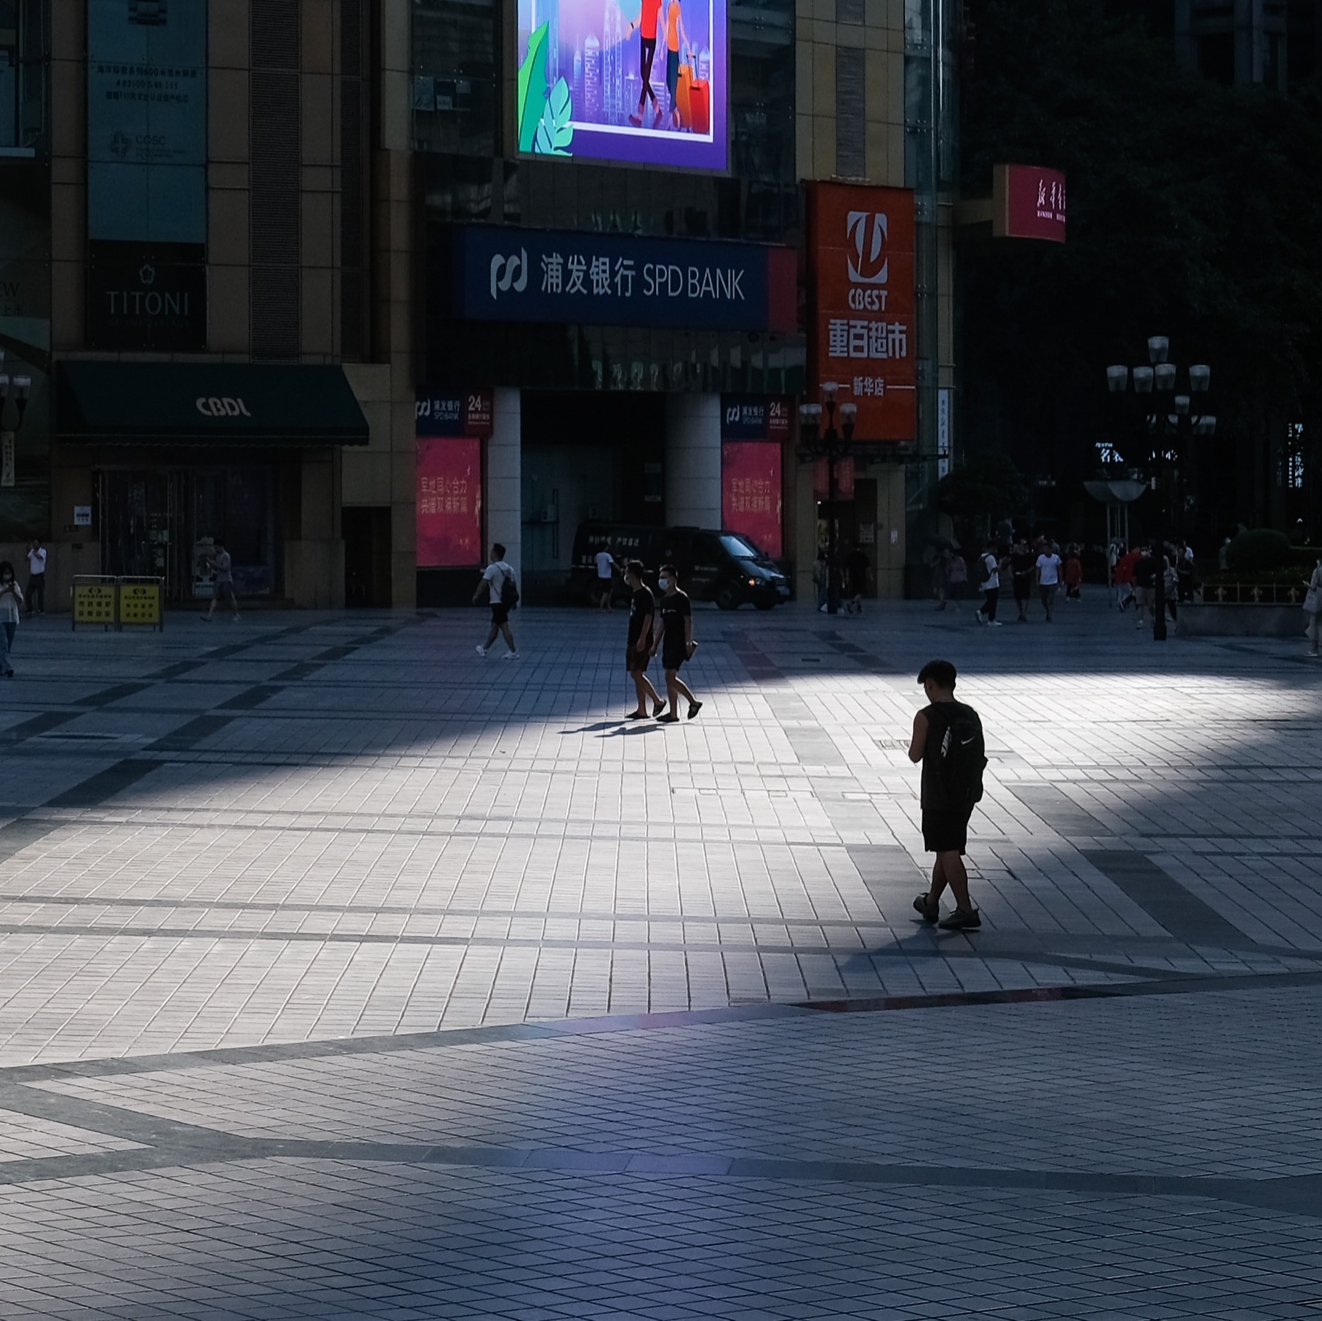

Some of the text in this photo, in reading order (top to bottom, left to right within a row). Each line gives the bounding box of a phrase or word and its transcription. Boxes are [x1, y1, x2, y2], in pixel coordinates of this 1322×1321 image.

[135, 135, 167, 146] COSC
[540, 252, 636, 298] 浦发银行
[643, 263, 745, 300] SPD BANK
[105, 291, 189, 315] TITONI
[848, 288, 888, 311] CBEST
[828, 319, 907, 359] 重百超市
[853, 377, 884, 397] 新华店
[434, 400, 461, 411] 浦发银行
[468, 394, 482, 411] 24
[770, 402, 781, 417] 24
